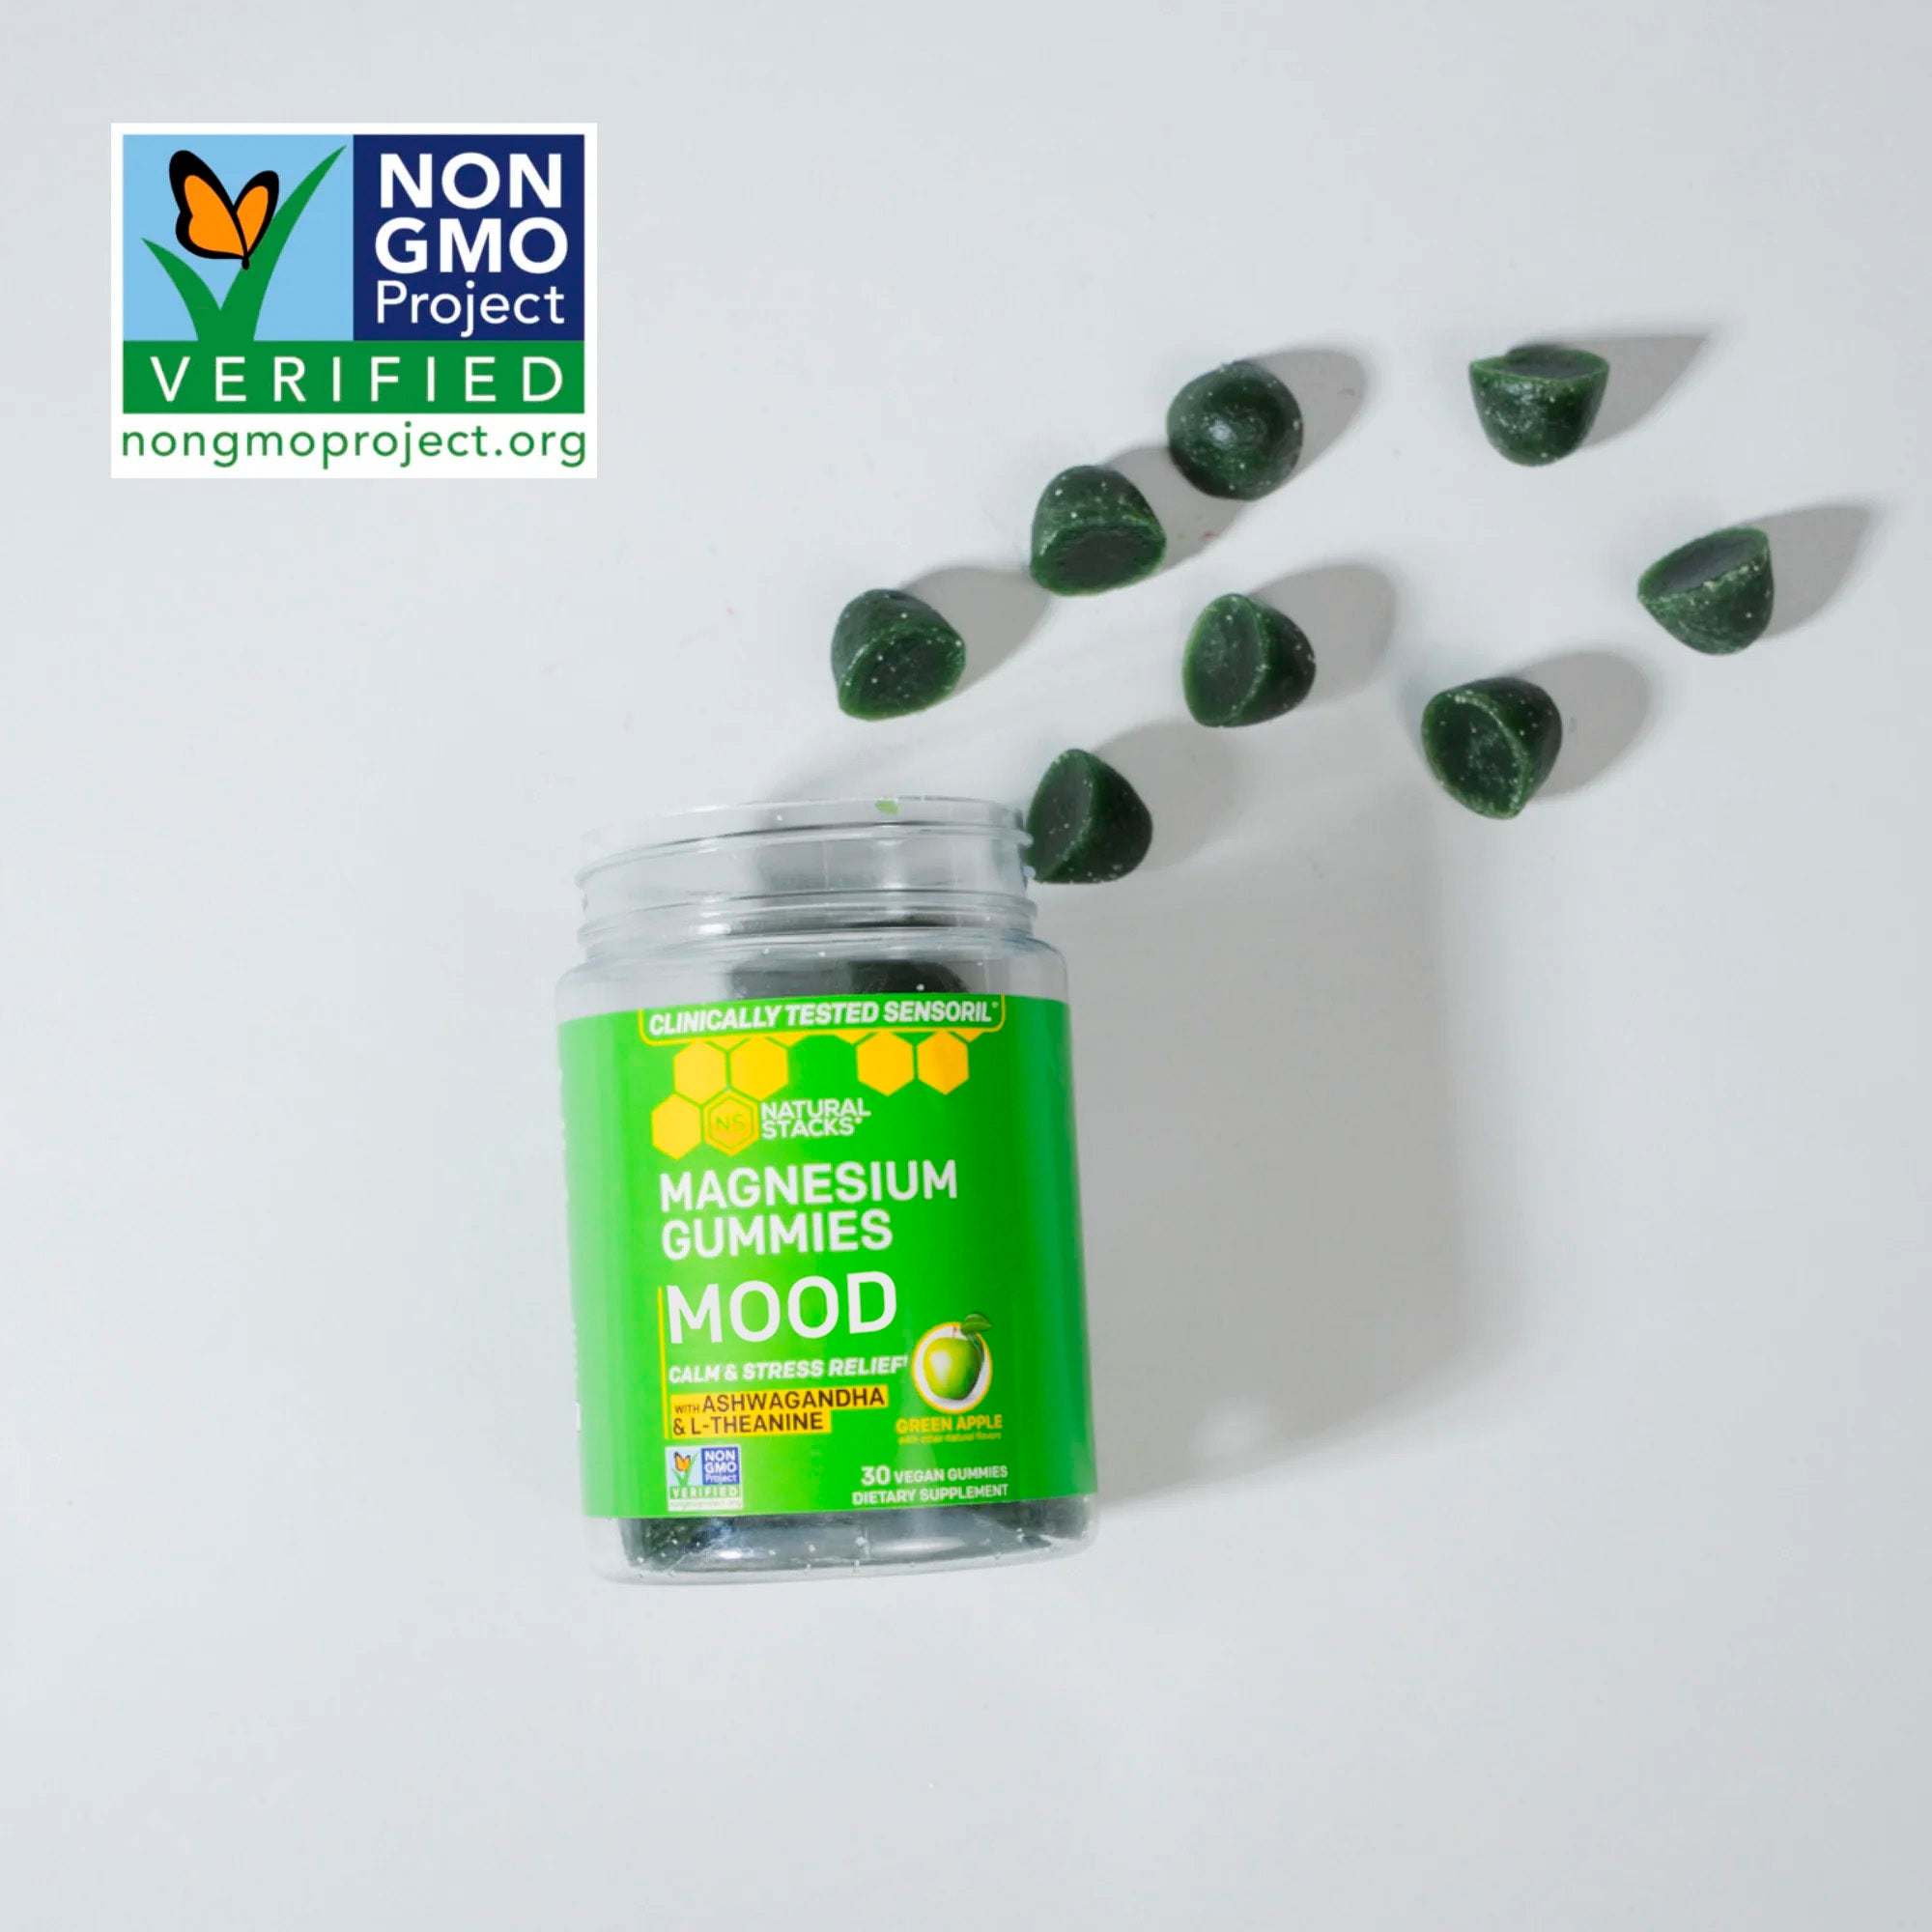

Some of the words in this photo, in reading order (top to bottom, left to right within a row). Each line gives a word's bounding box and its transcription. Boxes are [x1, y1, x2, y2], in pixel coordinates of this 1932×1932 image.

[649, 1005, 781, 1037] CLINICALLY
[784, 1001, 880, 1027] TESTED
[760, 1097, 872, 1121] NATURAL
[716, 1113, 746, 1133] NS
[659, 1159, 958, 1212] MAGNESIUM
[661, 1208, 894, 1262] GUMMIES
[666, 1270, 897, 1345] MOOD
[668, 1363, 720, 1383] CALM
[724, 1363, 738, 1381] &
[742, 1358, 824, 1379] STRESS
[674, 1404, 700, 1414] WITH
[702, 1387, 886, 1413] ASHWAGANDHA
[672, 1417, 686, 1435] &
[690, 1411, 824, 1435] L-THEANINE
[895, 1417, 952, 1435] GREEN
[955, 1414, 1003, 1431] APPLE
[704, 1449, 736, 1462] NON
[704, 1462, 737, 1474] GMO
[861, 1464, 891, 1487] 30
[894, 1467, 946, 1485] VEGAN
[947, 1464, 1009, 1482] GUMMIES
[672, 1486, 738, 1498] VERIFIED
[851, 1488, 917, 1506] DIETARY
[919, 1483, 1009, 1502] SUPPLEMENT
